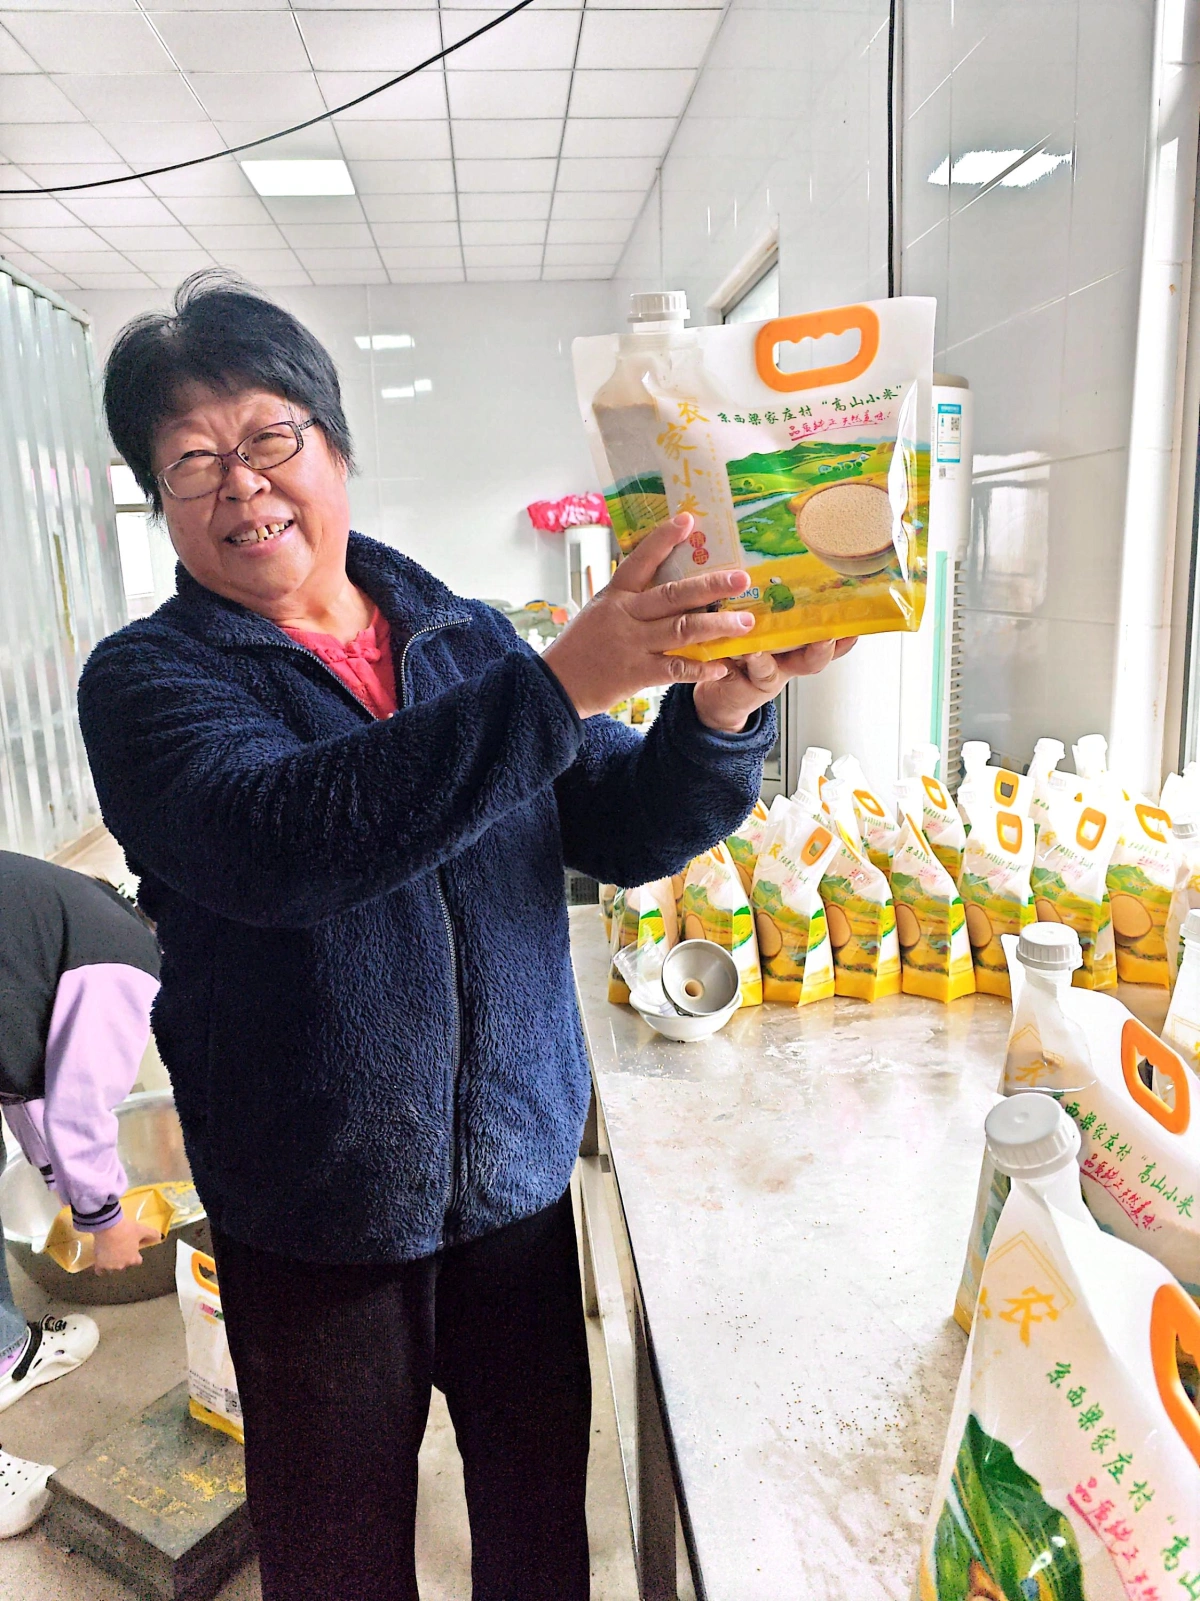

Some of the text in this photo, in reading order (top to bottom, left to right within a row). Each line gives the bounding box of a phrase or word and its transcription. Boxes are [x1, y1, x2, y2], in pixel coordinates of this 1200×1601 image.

[1053, 1091, 1132, 1162] 西梁家庄村
